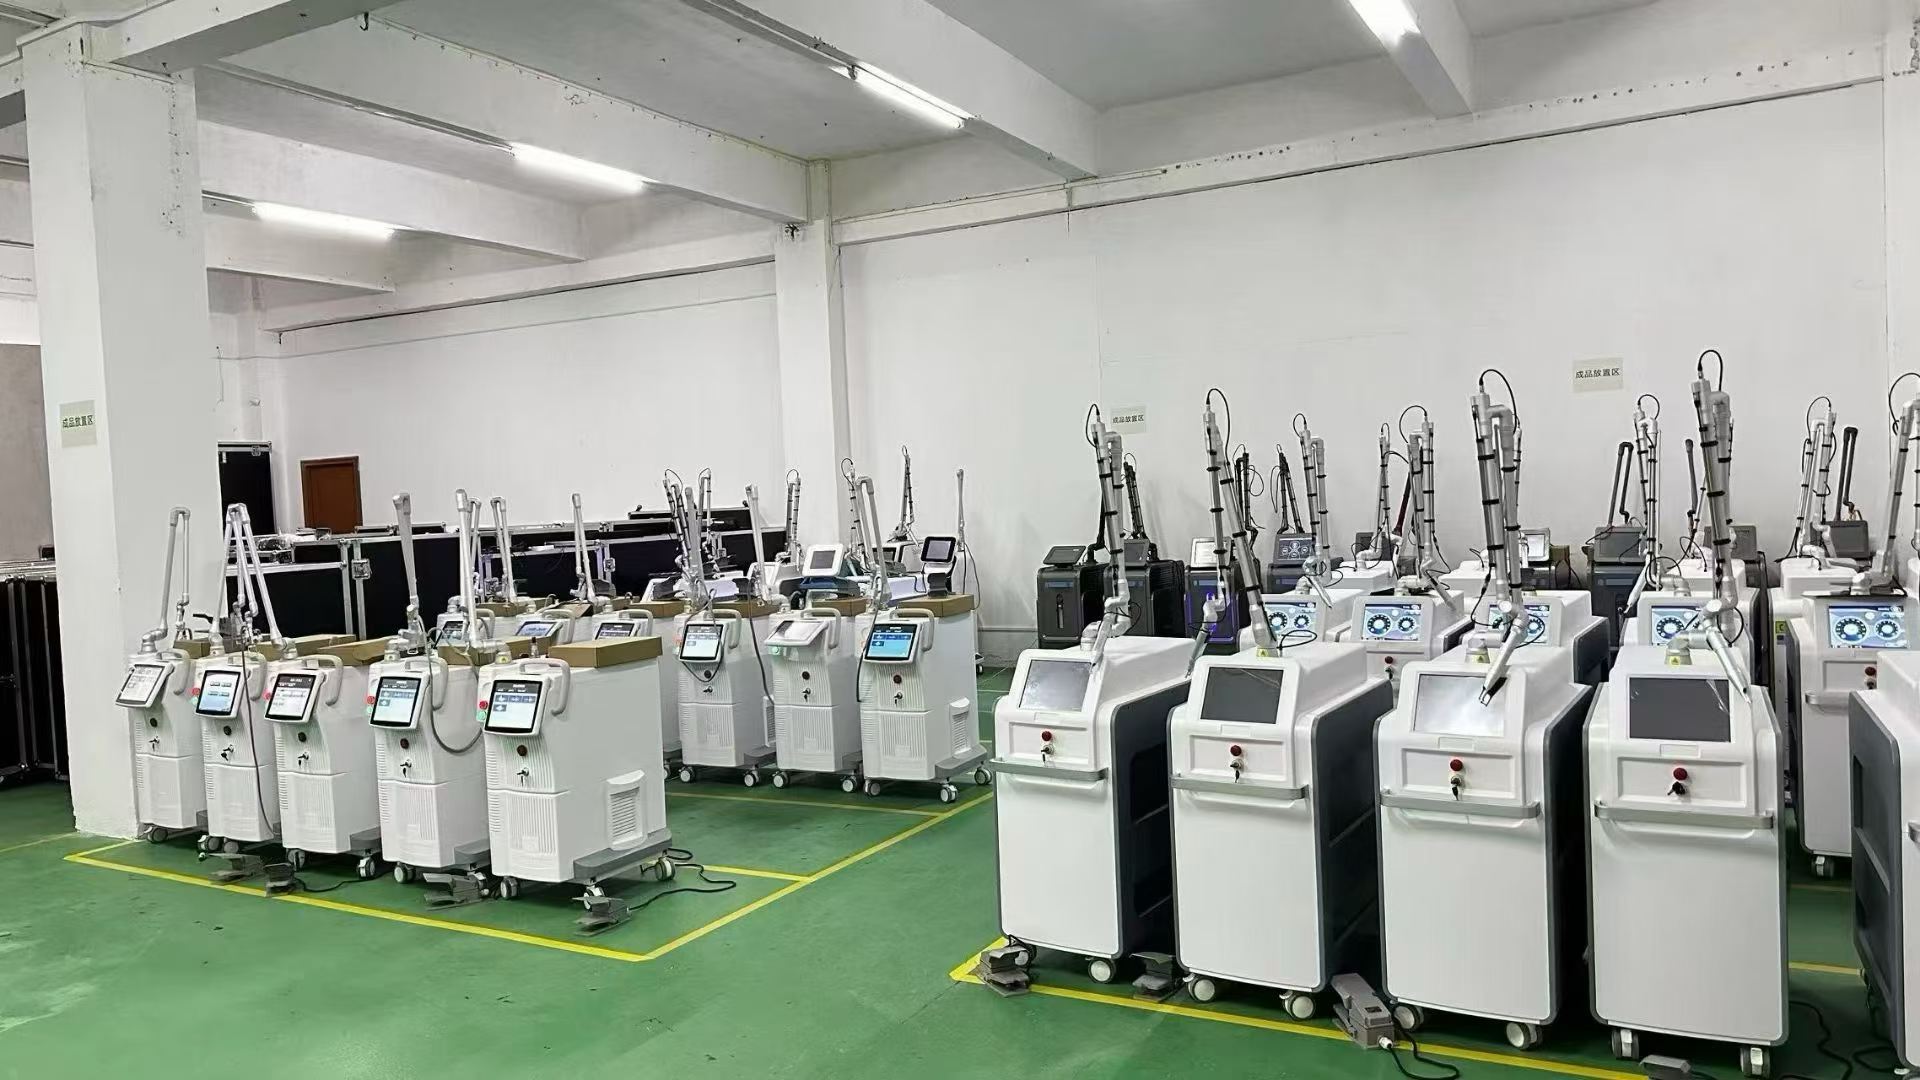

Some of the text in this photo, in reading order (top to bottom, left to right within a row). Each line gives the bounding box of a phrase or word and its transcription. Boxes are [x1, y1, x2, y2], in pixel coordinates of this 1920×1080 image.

[1575, 367, 1620, 379] 成品放置区
[62, 415, 94, 428] 成品放置区
[1112, 414, 1144, 424] 成品放置区
